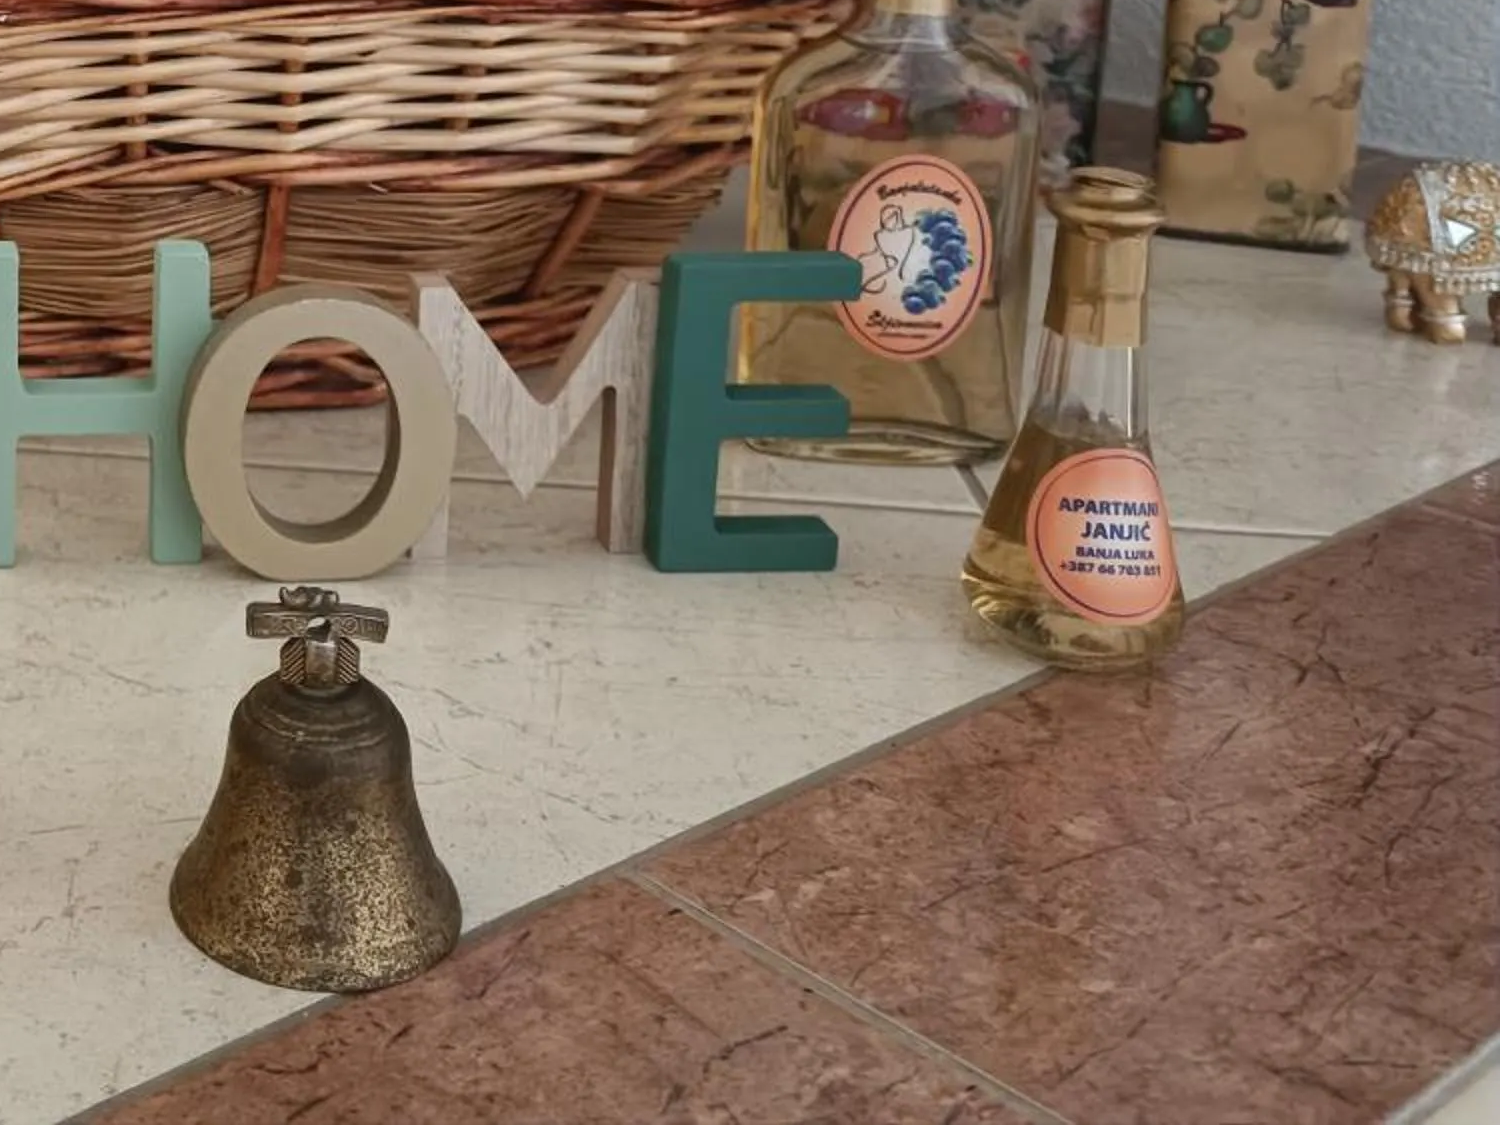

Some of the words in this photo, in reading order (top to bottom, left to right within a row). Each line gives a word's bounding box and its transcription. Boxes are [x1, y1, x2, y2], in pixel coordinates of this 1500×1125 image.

[1081, 520, 1151, 541] JANJIĆ
[1076, 546, 1122, 560] BANJA
[1124, 549, 1155, 560] LUKA
